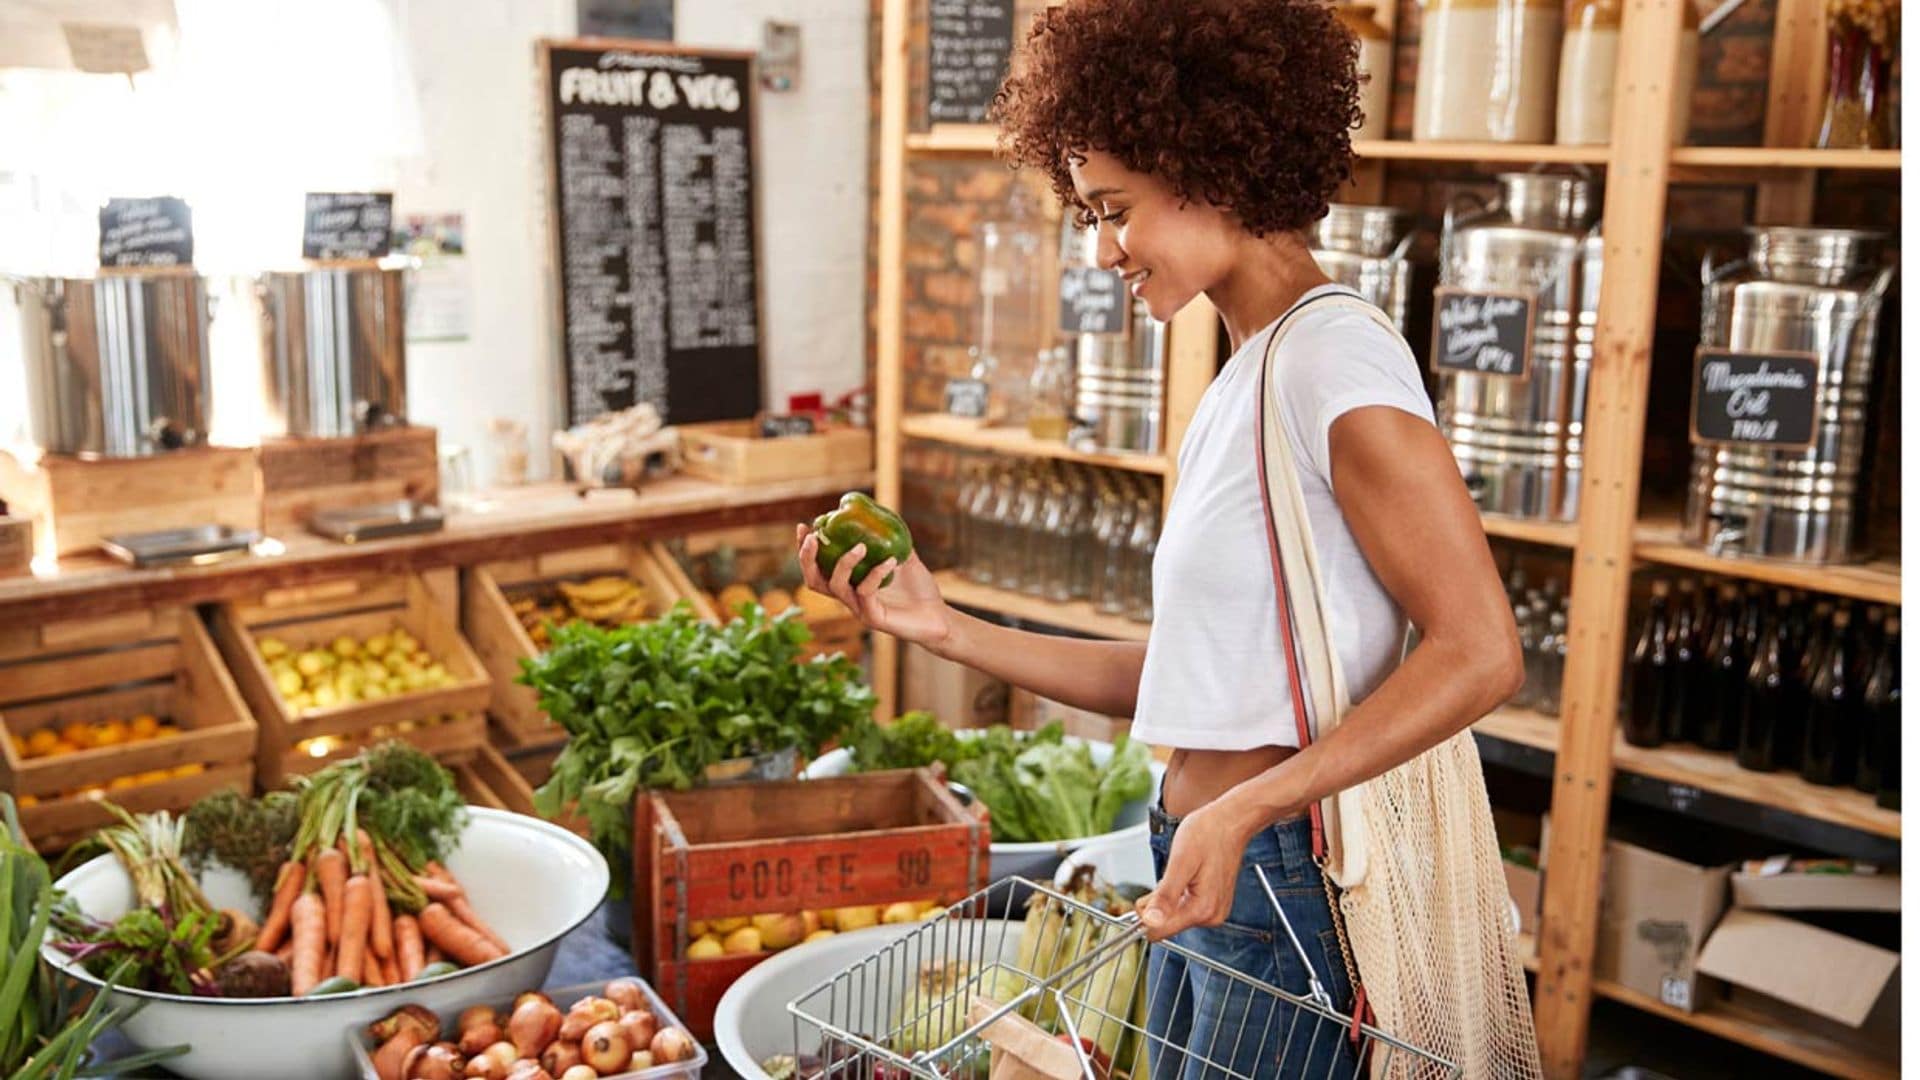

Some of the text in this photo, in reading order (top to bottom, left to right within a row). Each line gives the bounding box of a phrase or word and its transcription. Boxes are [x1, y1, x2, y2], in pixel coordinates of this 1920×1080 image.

[560, 67, 740, 112] FRUIT & VEG
[1726, 385, 1770, 418] Oil
